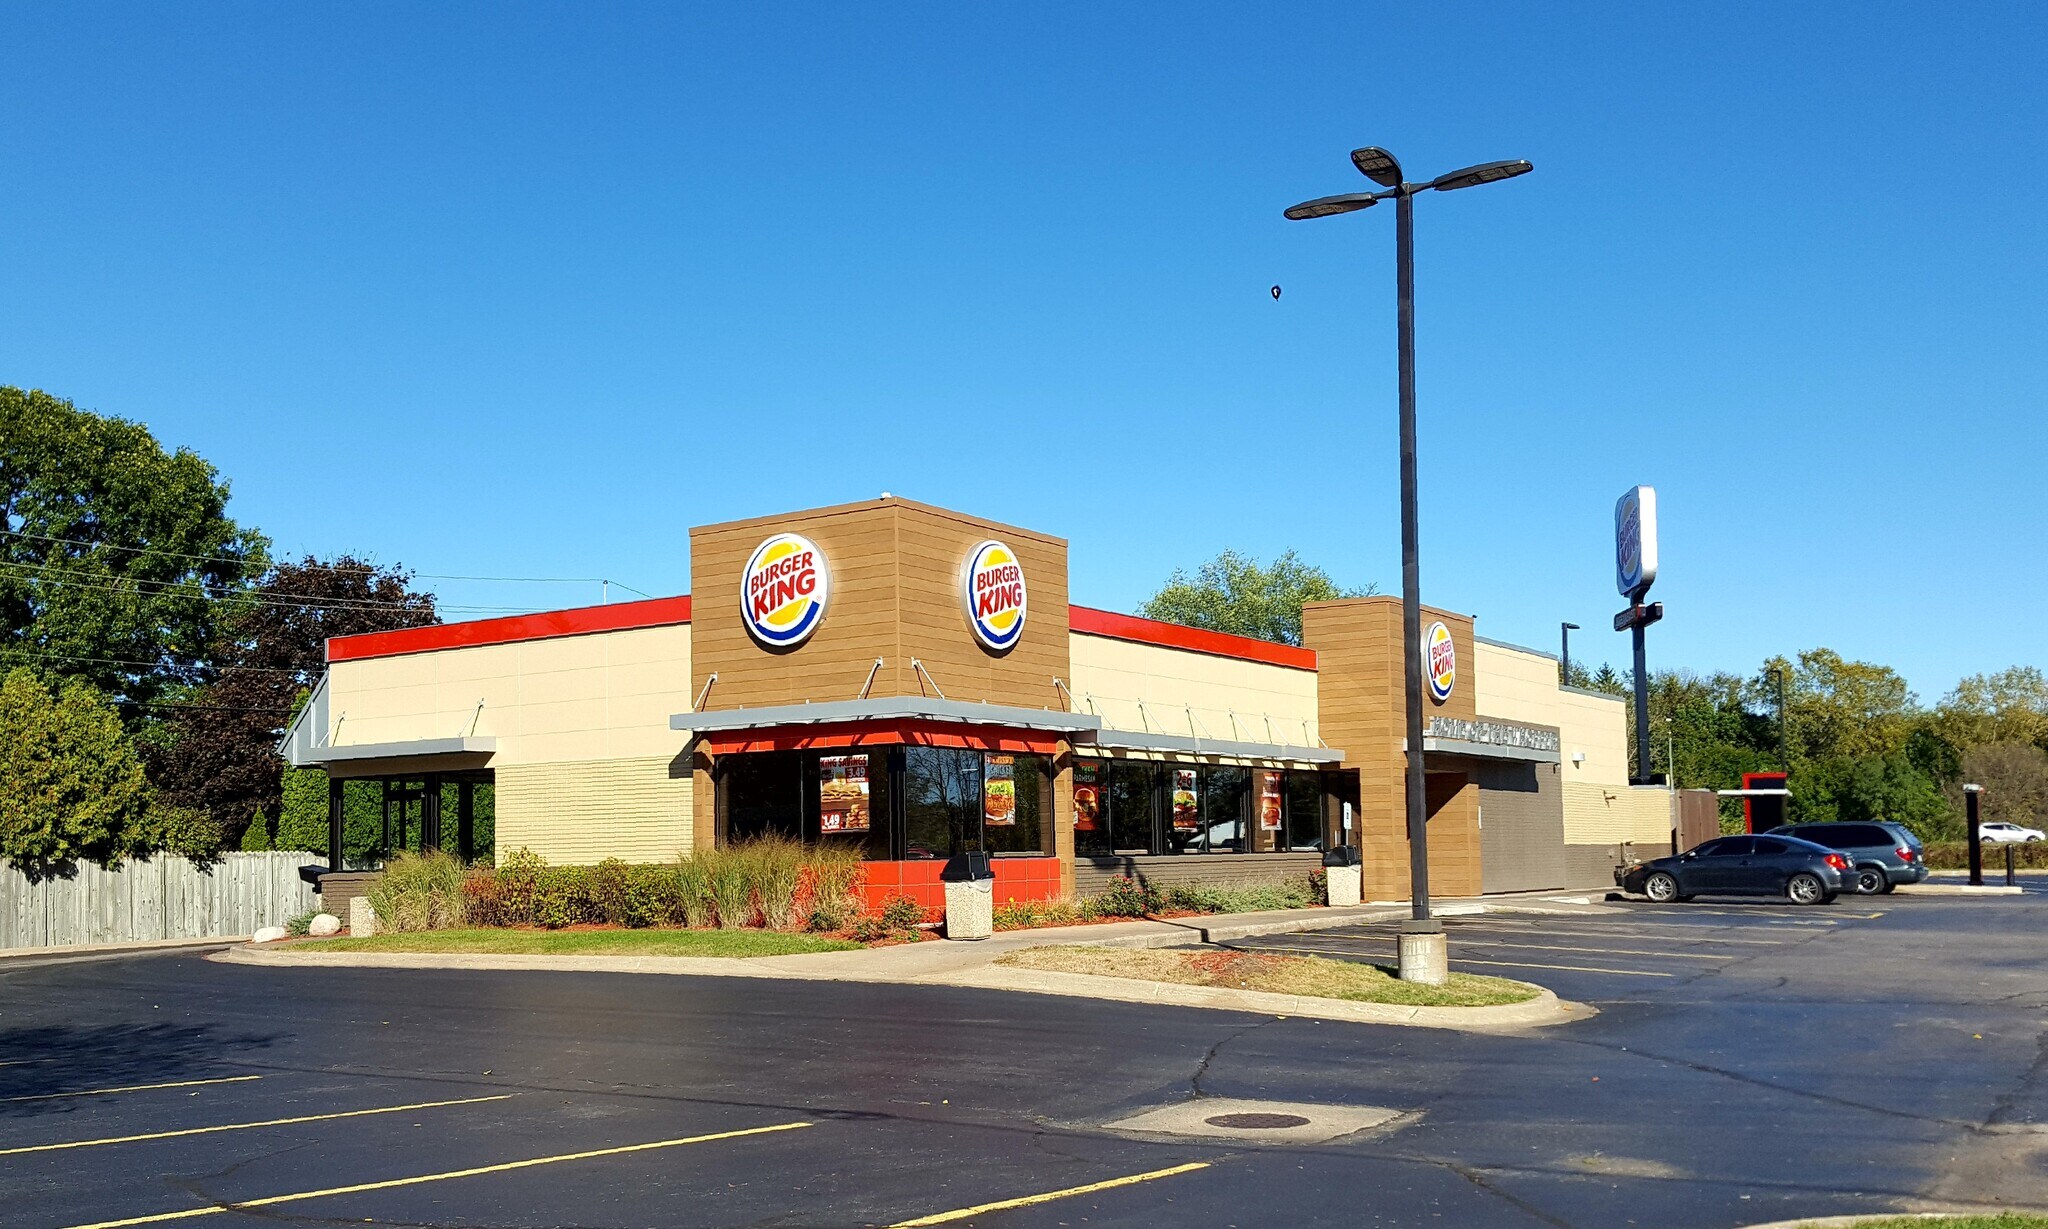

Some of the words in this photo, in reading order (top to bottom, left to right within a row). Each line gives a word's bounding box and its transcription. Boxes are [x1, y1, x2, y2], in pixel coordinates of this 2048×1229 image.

[751, 552, 813, 597] BURGER
[977, 566, 1020, 592] BURGER
[754, 569, 816, 623] KING
[978, 583, 1022, 619] KING
[820, 758, 837, 768] KING
[838, 756, 867, 768] SAVINGS
